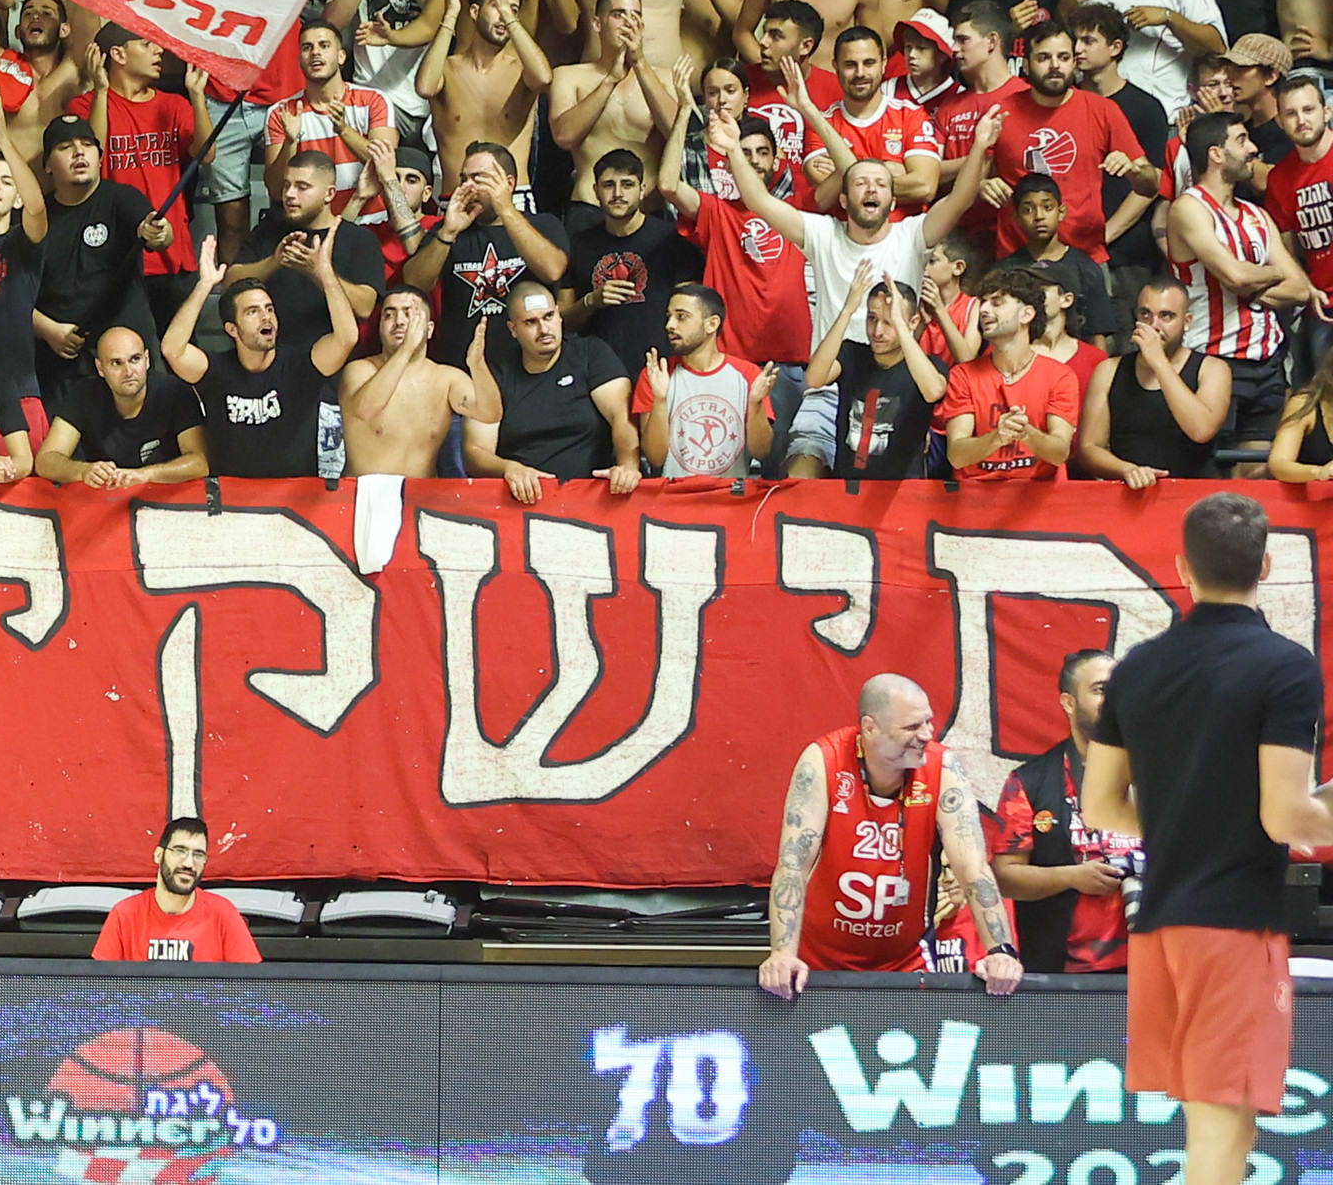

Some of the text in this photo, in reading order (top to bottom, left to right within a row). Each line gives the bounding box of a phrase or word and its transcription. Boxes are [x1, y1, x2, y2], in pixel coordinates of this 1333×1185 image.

[109, 132, 178, 152] ULTRA
[678, 400, 736, 427] ULTRAS
[678, 447, 733, 471] HAPOEL
[853, 821, 901, 861] 20
[833, 917, 904, 939] metzer
[148, 939, 190, 961] אהבה
[143, 1083, 223, 1115] ליגת
[590, 1024, 750, 1151] סל
[225, 1104, 279, 1147] סל
